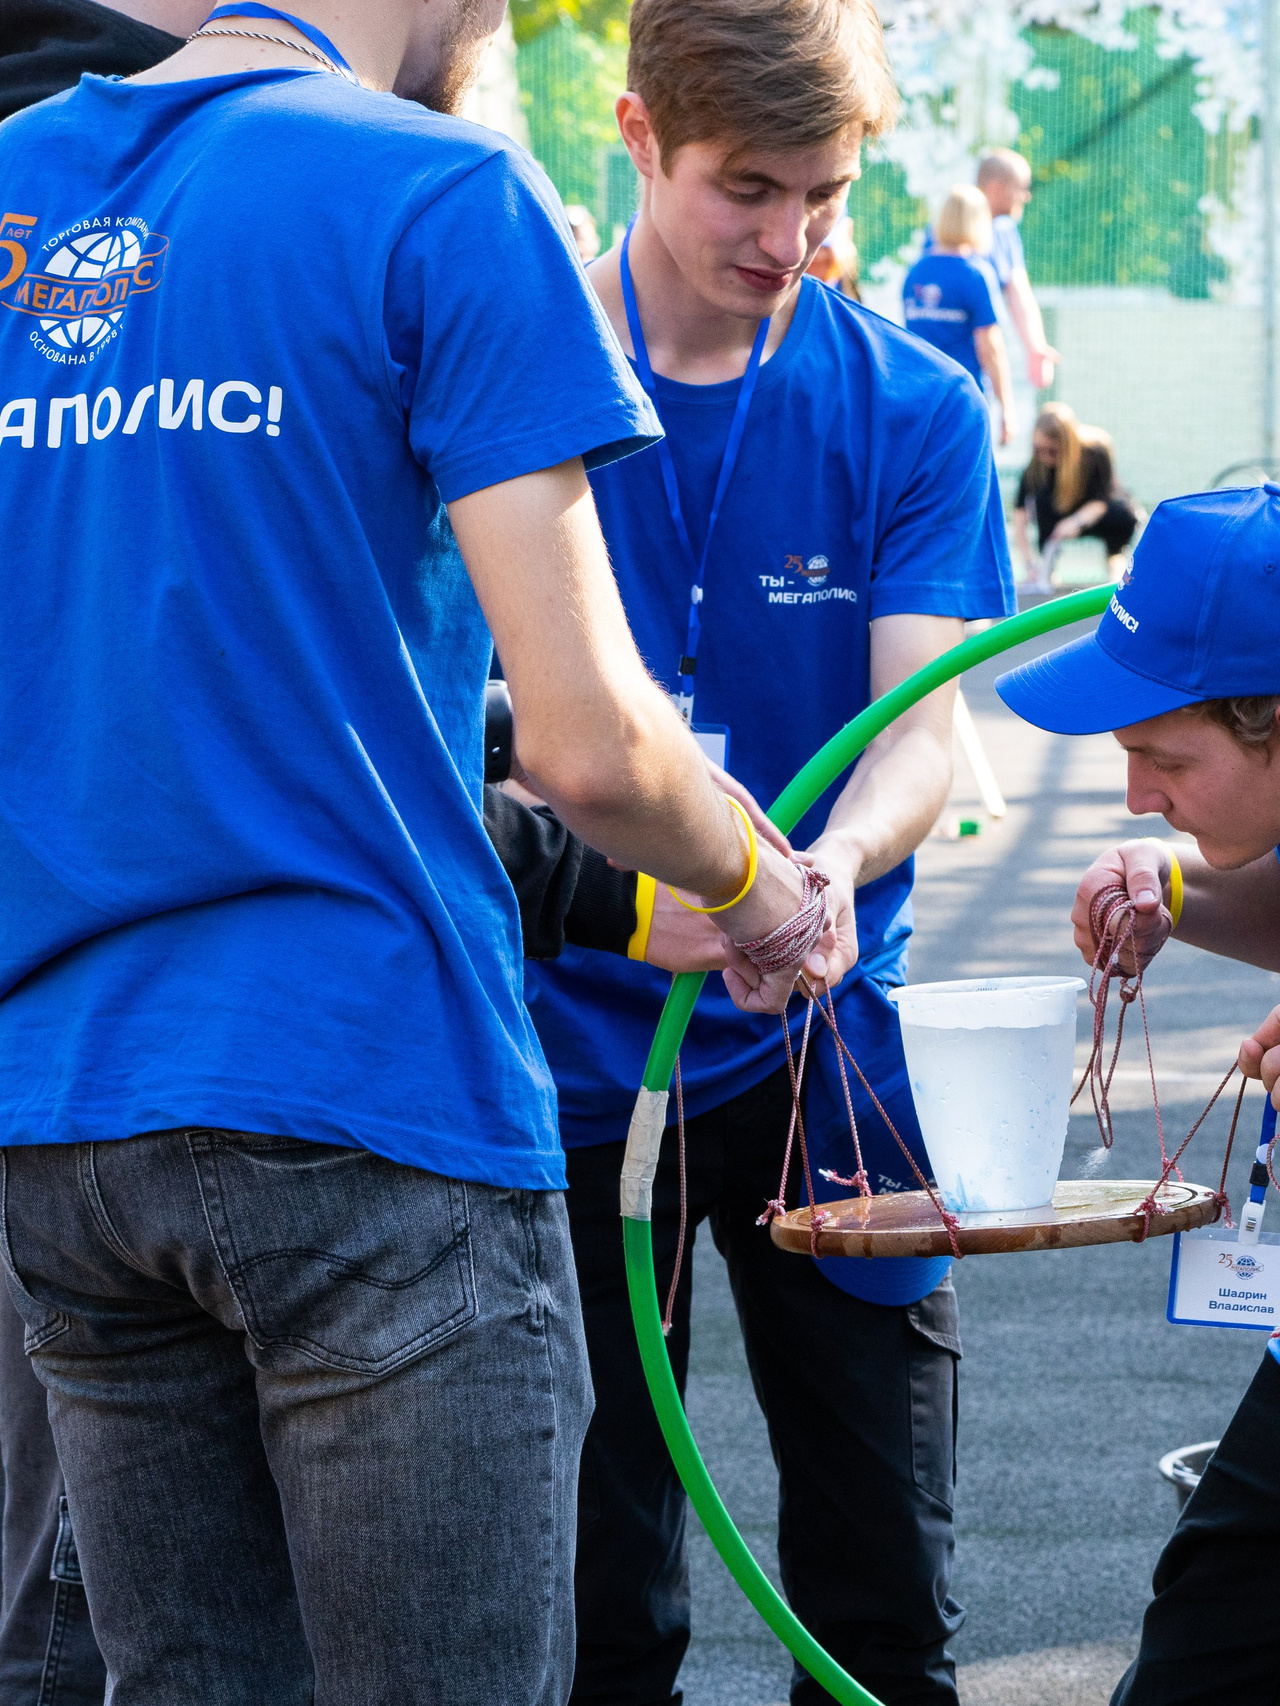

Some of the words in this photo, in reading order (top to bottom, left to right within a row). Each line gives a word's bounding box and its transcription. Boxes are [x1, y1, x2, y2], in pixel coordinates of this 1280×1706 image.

[42, 217, 111, 252] ТОРГОВАЯ
[14, 260, 154, 312] МЕГАПОЛС
[29, 331, 87, 365] ОСНОВАНА
[784, 554, 803, 574] 25
[759, 575, 785, 588] ТЫ
[1218, 1253, 1233, 1268] 25
[1218, 1287, 1267, 1300] Шадрин
[1208, 1300, 1274, 1314] Владислав
